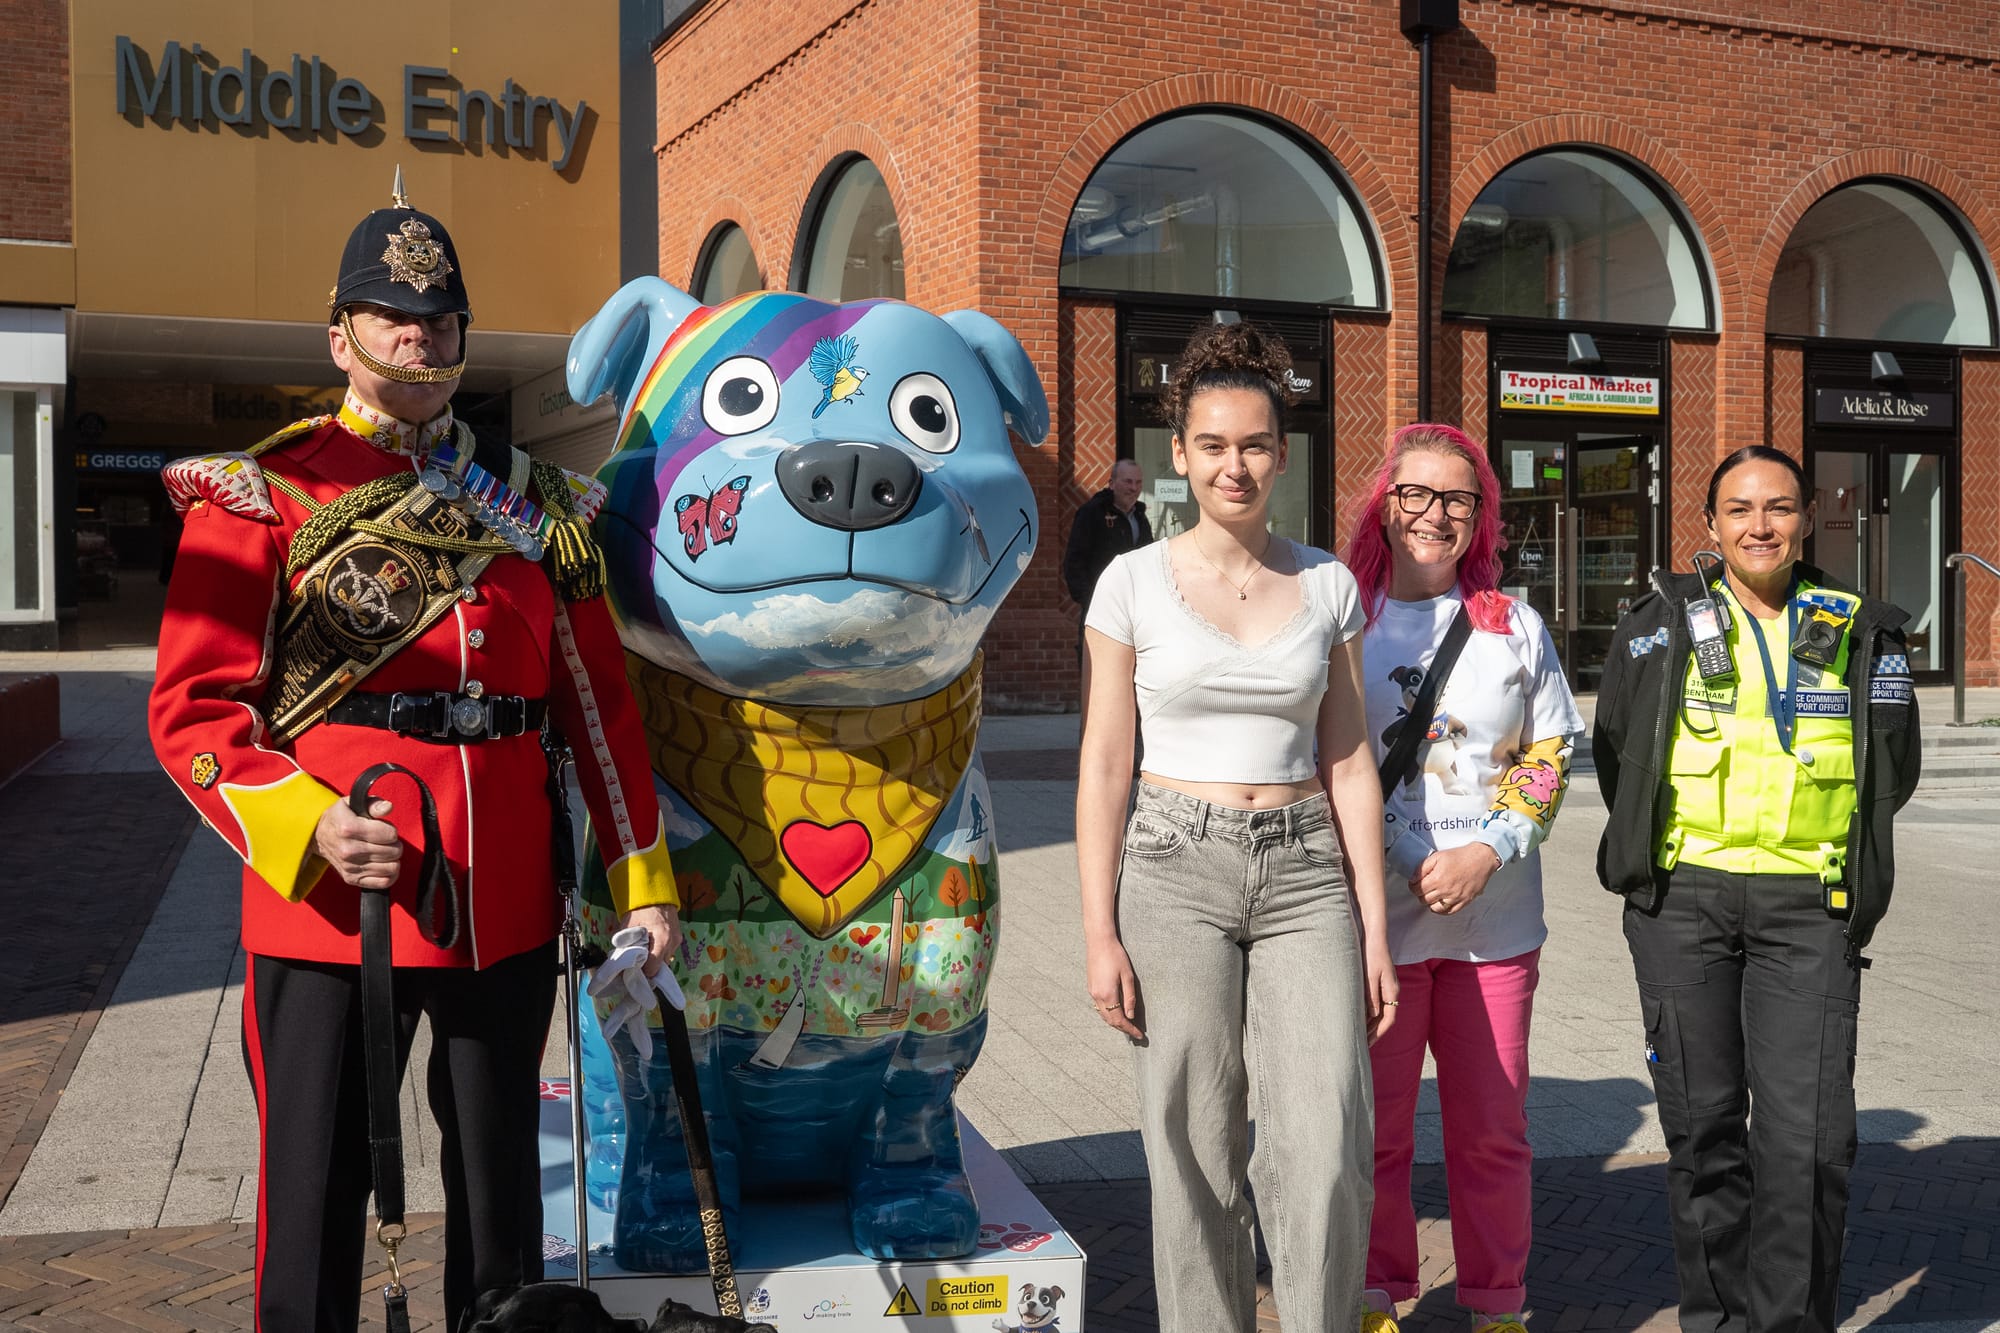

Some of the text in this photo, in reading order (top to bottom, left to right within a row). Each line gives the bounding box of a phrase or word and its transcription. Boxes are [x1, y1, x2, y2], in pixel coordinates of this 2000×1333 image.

[115, 35, 586, 171] Middle Entry
[1507, 373, 1653, 393] Tropical Market
[1568, 392, 1654, 404] AFRICAN & CARIBBEAN SHOP
[212, 392, 282, 420] iddle
[1841, 396, 1929, 417] Adelia & Rose
[91, 454, 162, 469] GREGGS
[1521, 550, 1541, 565] Open
[1684, 689, 1725, 699] BENTHAM
[1806, 694, 1848, 704] COMMUNITY
[1872, 690, 1893, 698] PPORT
[1818, 703, 1845, 712] OFFICER
[940, 1281, 995, 1296] Caution
[931, 1298, 1002, 1312] Do not climb
